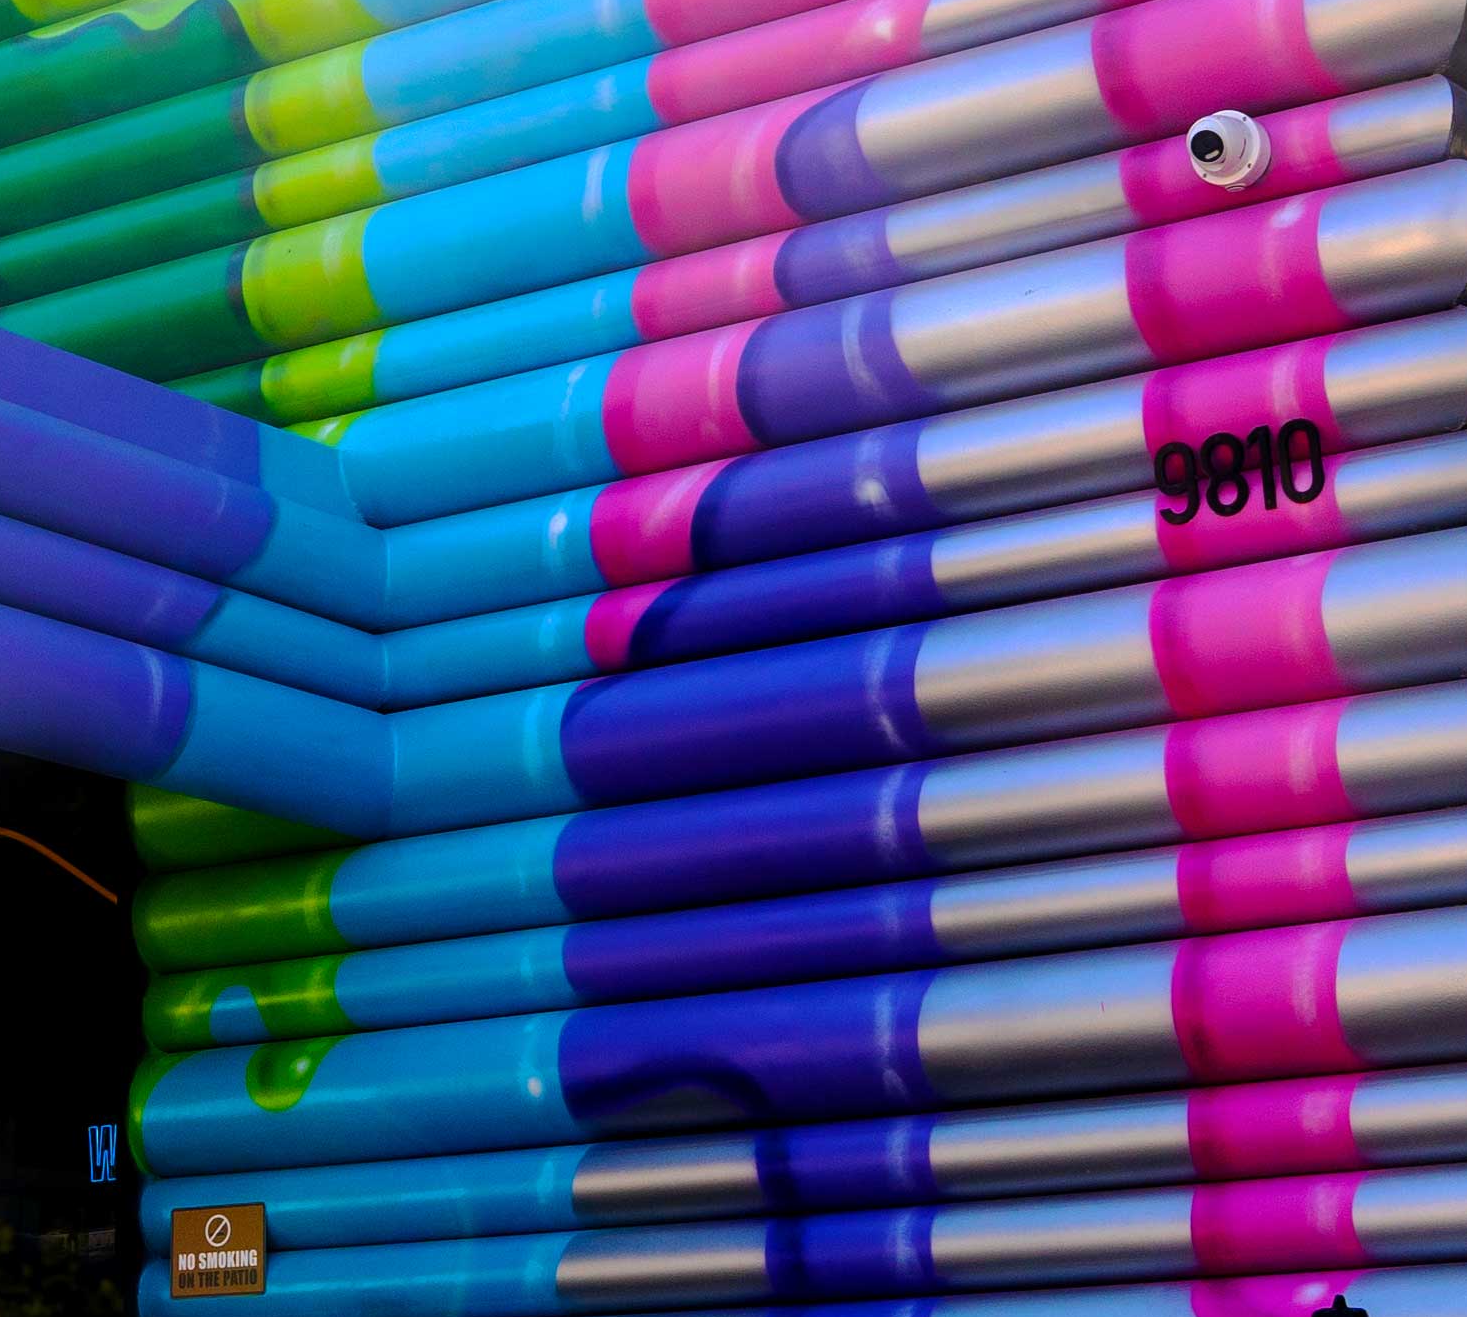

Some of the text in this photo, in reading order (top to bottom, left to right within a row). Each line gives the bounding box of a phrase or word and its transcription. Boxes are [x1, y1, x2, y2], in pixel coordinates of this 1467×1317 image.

[1155, 419, 1325, 525] 9810
[178, 1249, 258, 1271] NO SMOKING
[178, 1268, 258, 1289] ON THE PATIO
